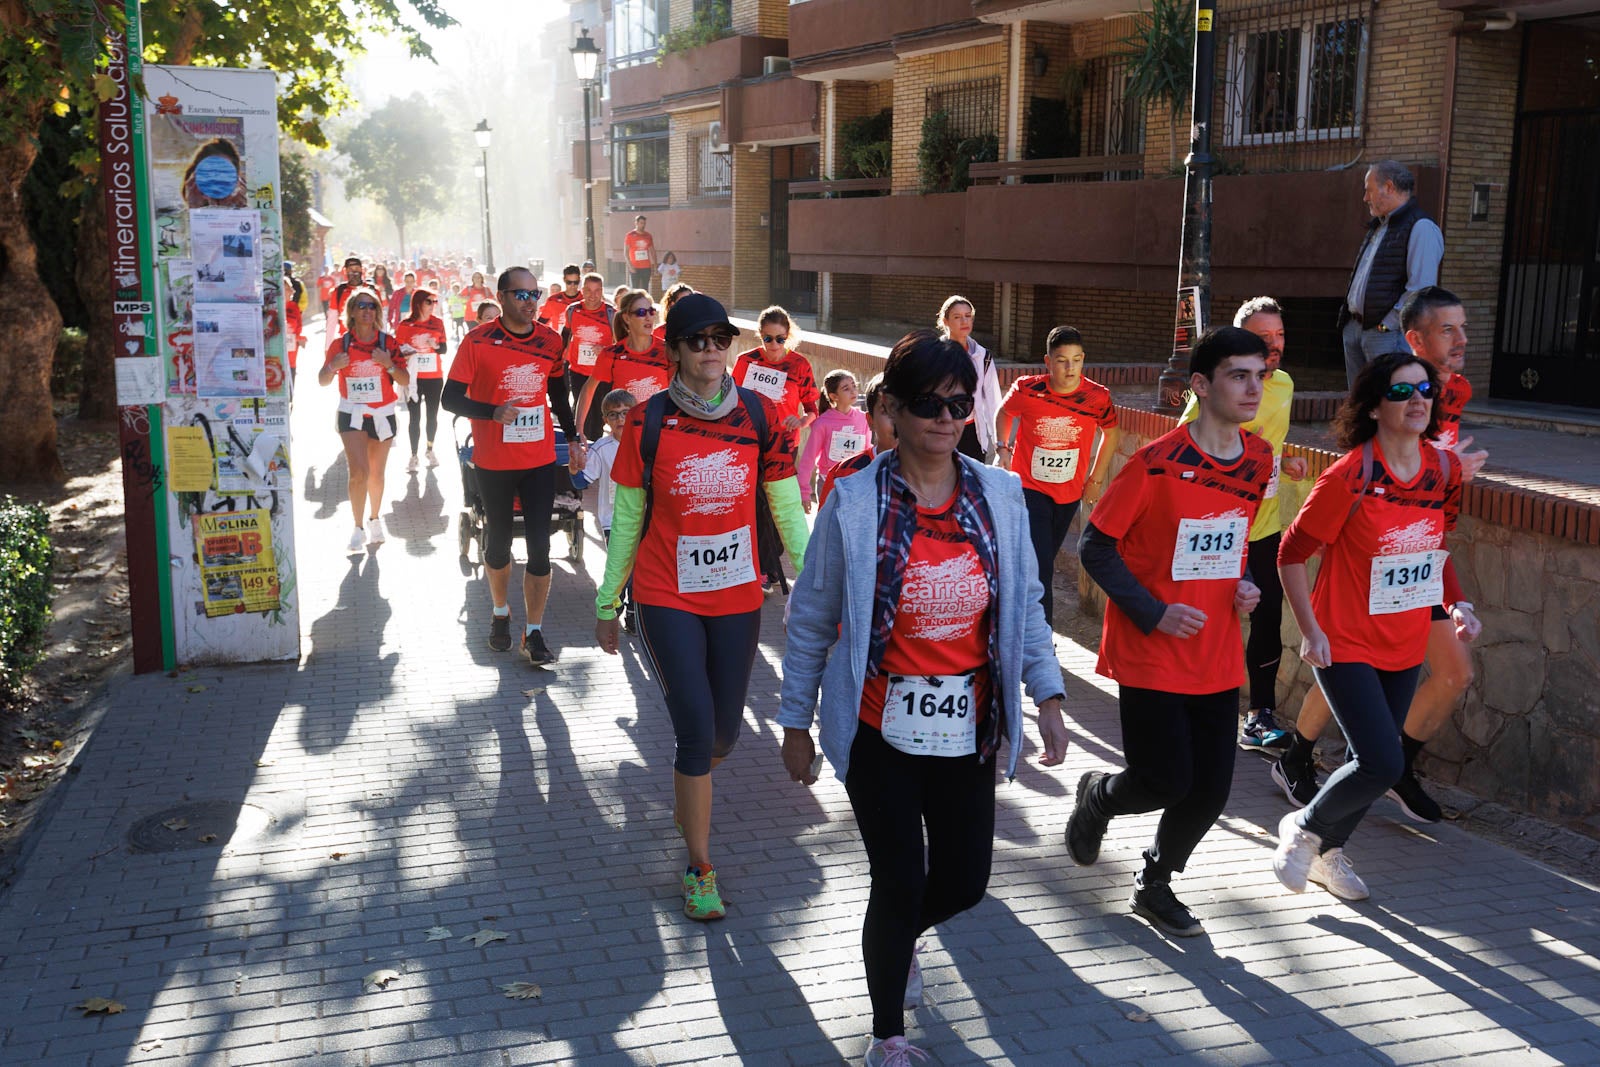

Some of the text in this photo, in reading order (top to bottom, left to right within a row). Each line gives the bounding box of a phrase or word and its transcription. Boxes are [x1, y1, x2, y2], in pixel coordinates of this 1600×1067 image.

[116, 303, 151, 312] MPS
[752, 371, 779, 386] 1660
[351, 382, 375, 391] 1413
[843, 439, 856, 450] 41
[1039, 456, 1072, 468] 1227
[678, 467, 746, 484] carrera
[678, 481, 746, 495] cruzroja.es
[204, 517, 259, 531] MOLINA
[241, 531, 263, 557] B
[1189, 532, 1235, 552] 1313
[1379, 536, 1441, 556] carrera
[689, 542, 740, 566] 1047
[1384, 563, 1432, 586] 1310
[242, 576, 264, 590] 149
[902, 578, 989, 600] carrera
[902, 598, 990, 614] cruzroja.es
[916, 618, 927, 626] 19
[930, 618, 952, 626] NOV
[902, 691, 969, 719] 1649
